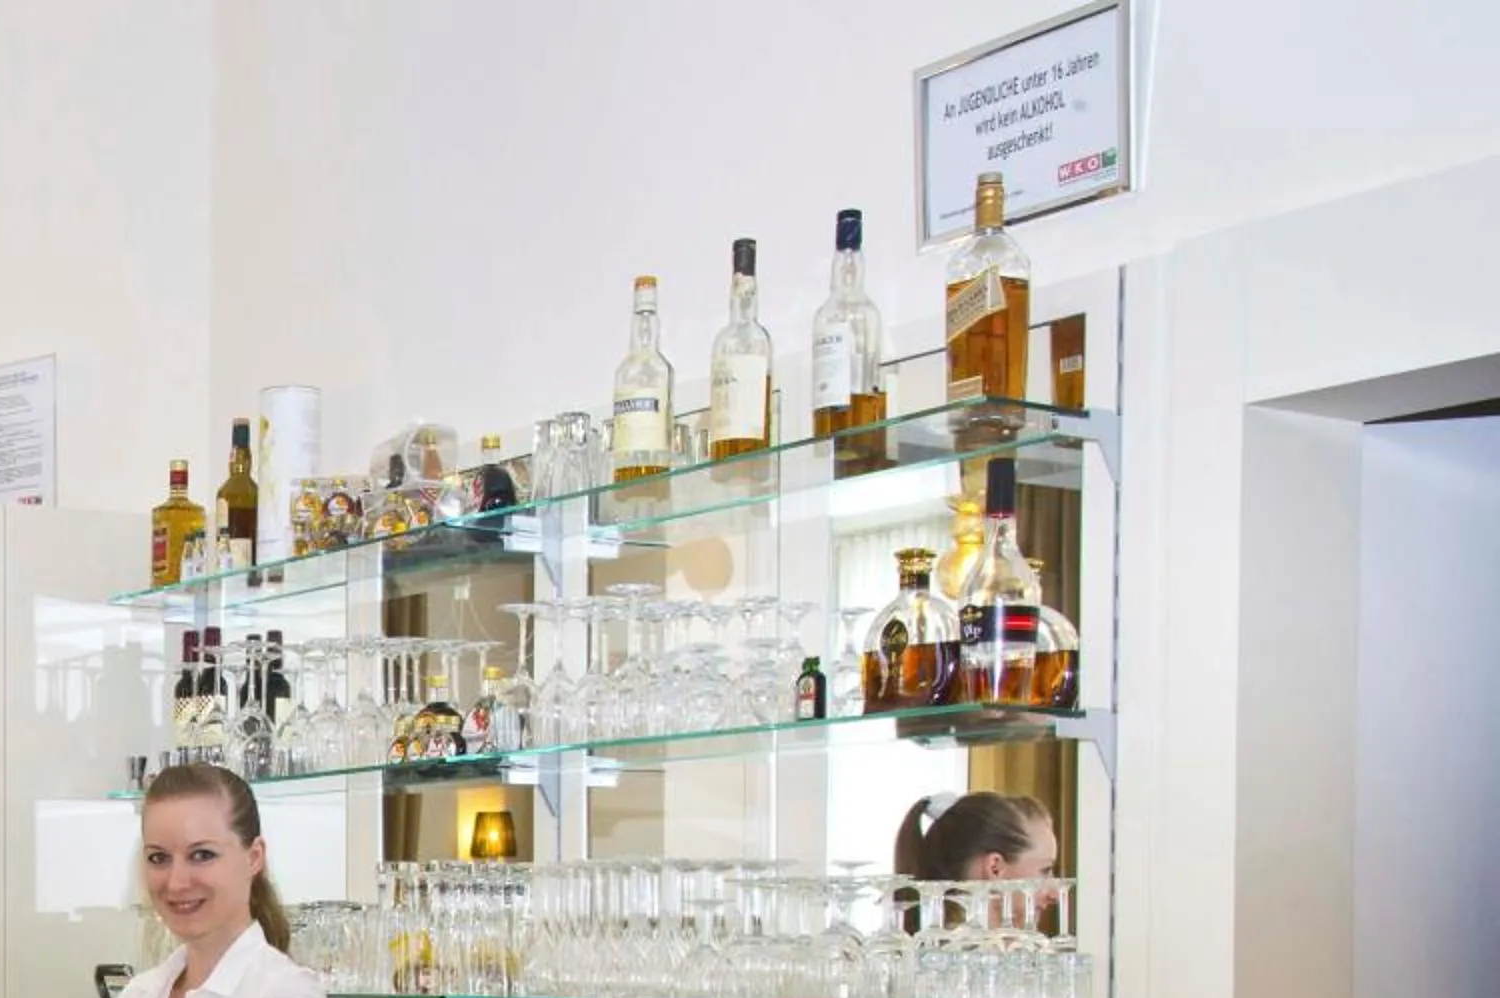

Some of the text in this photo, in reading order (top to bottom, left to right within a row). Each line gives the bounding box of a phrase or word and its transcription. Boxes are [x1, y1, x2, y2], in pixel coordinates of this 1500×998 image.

[958, 76, 1019, 116] JUGENDLICHE
[1021, 71, 1048, 94] unter
[1051, 61, 1063, 81] 16
[1065, 51, 1100, 78] Jahren
[975, 90, 1066, 135] wird kein ALKOHOL
[986, 122, 1053, 161] ausgeschenkt!
